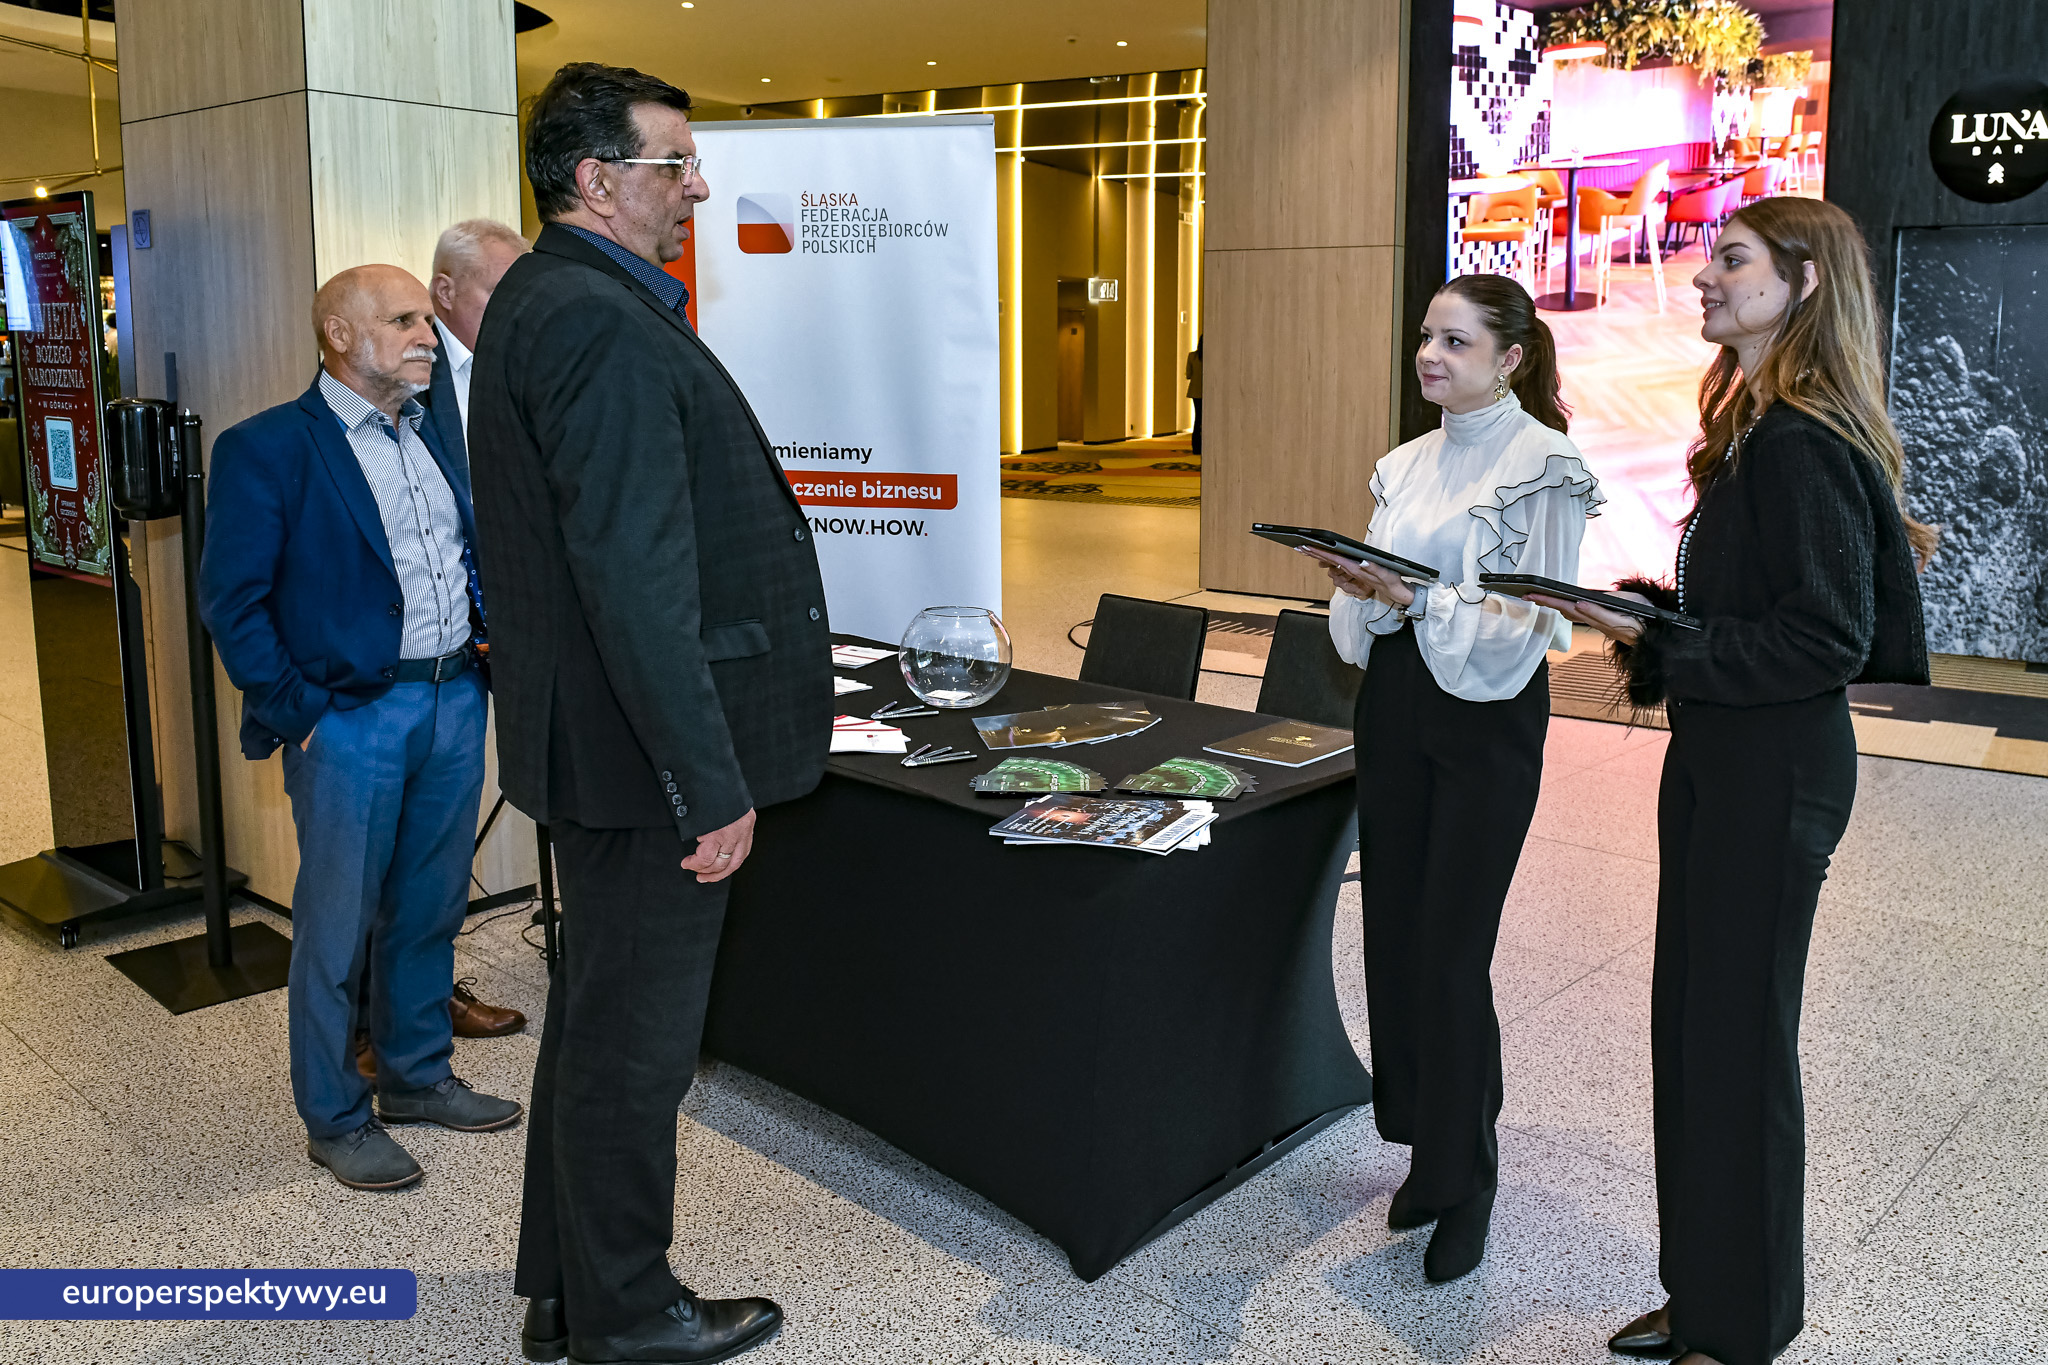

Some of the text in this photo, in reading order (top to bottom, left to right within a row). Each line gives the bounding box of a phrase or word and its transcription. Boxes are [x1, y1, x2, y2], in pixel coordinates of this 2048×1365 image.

[1972, 144, 2024, 156] BAR
[801, 191, 858, 209] ŚLĄSKA
[801, 208, 889, 223] FEDERACJA
[802, 220, 948, 240] PRZEDSIĘBIORCÓW
[802, 239, 876, 253] POLSKICH
[27, 367, 86, 389] NARODZENIA
[773, 441, 872, 464] mieniamy
[791, 480, 942, 500] czenie biznesu
